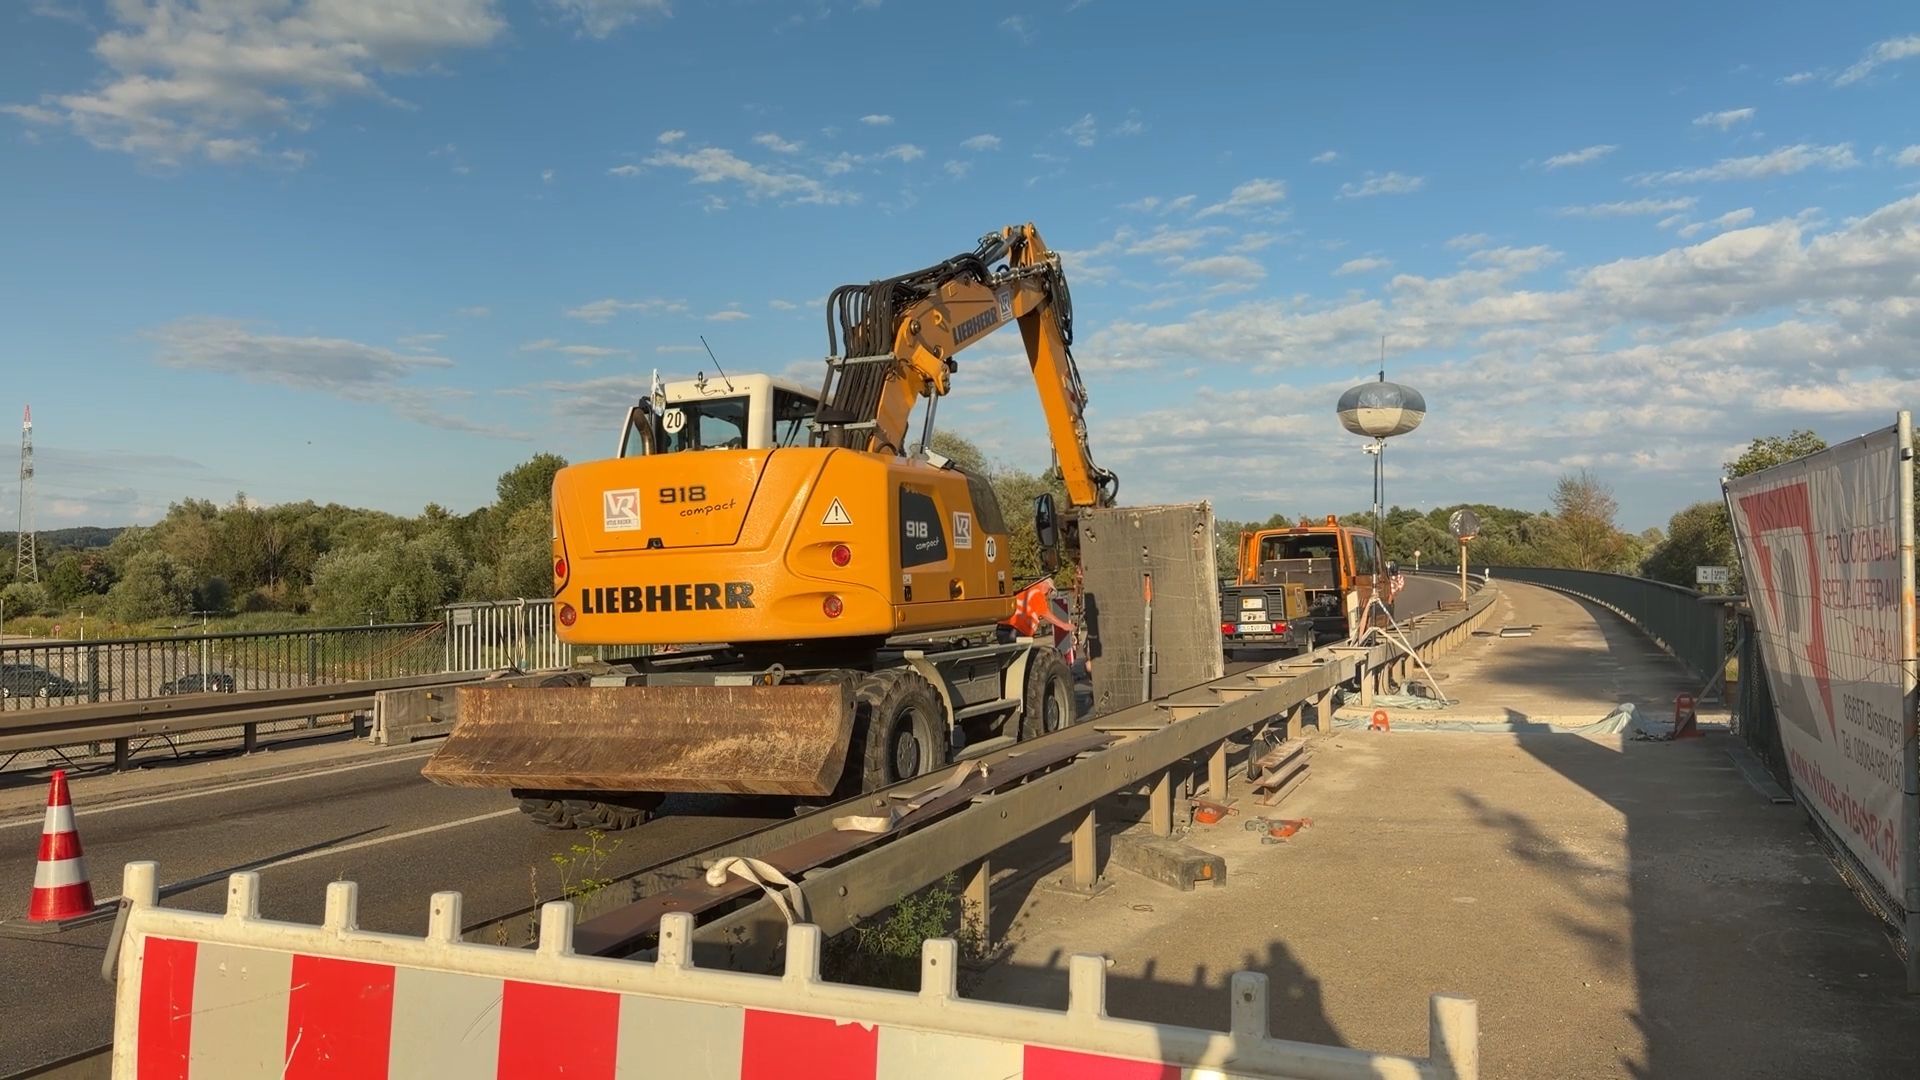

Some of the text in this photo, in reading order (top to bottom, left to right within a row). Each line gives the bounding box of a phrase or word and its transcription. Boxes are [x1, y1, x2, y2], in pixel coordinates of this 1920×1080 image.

[953, 308, 998, 345] LIEBHERR
[667, 412, 681, 428] 20
[659, 486, 706, 504] 918
[680, 500, 736, 517] compact
[906, 521, 928, 538] 918
[916, 537, 939, 550] compact
[987, 540, 995, 557] 20
[582, 582, 755, 614] LIEBHERR
